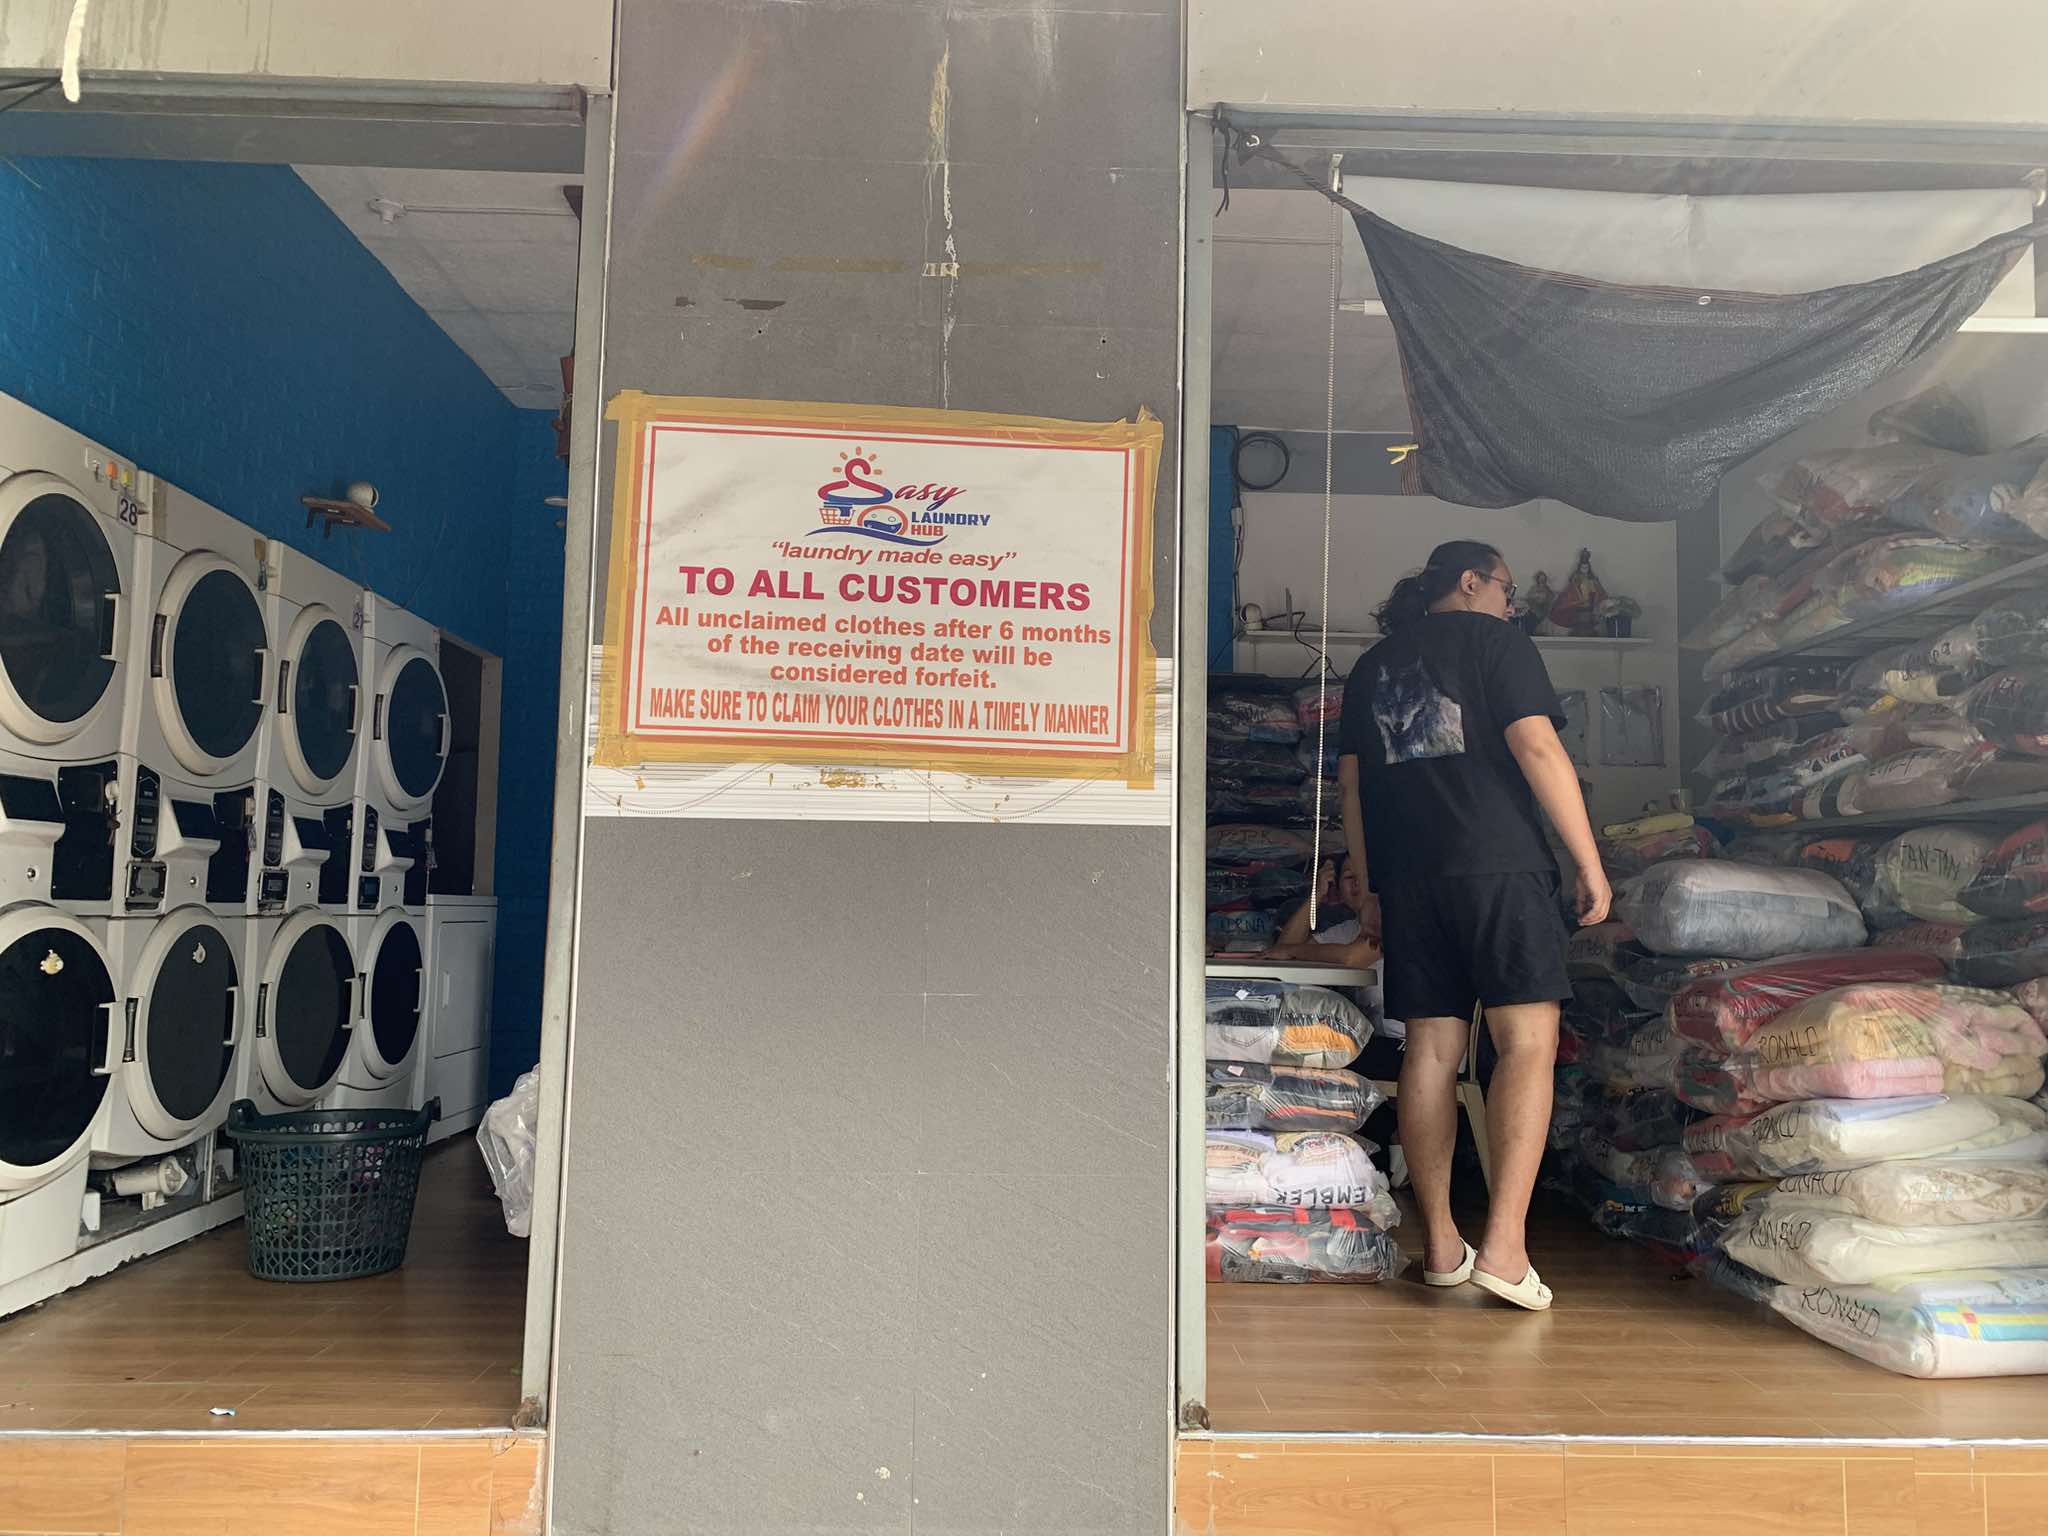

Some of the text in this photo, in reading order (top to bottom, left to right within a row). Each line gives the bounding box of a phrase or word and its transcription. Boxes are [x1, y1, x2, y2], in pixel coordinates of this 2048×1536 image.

[119, 498, 138, 526] 28
[911, 511, 990, 526] LAUNDRY
[911, 524, 944, 536] HUB
[877, 546, 943, 564] made
[679, 566, 1091, 611] TO ALL CUSTOMERS
[656, 606, 1112, 644] All unclaimed clothes after 6 months
[707, 634, 1053, 667] of the receiving date will be
[769, 663, 997, 689] considered forfeit.
[650, 687, 1110, 735] MAKE SURE TO CLAIM YOUR CLOTHES IN A TIMELY MANNER
[1758, 1025, 1818, 1064] RONALD
